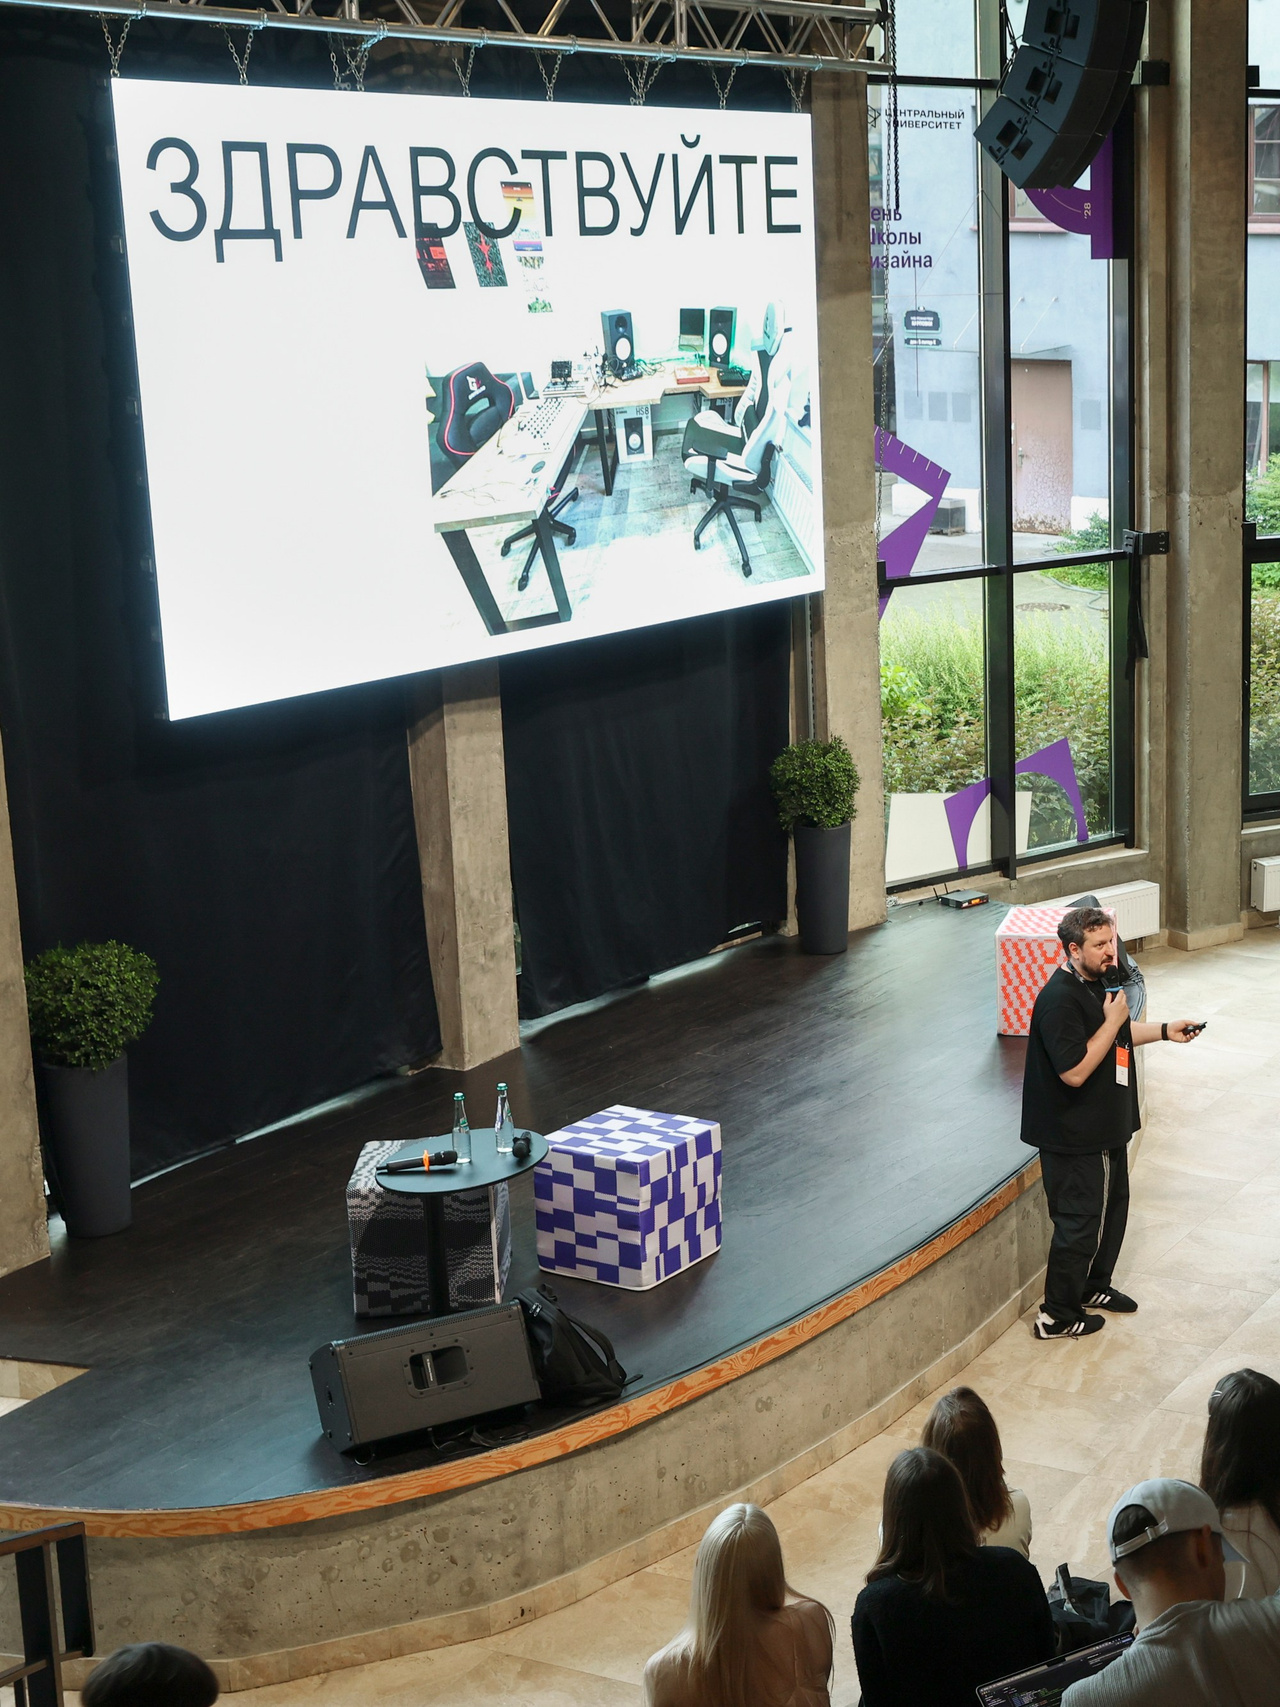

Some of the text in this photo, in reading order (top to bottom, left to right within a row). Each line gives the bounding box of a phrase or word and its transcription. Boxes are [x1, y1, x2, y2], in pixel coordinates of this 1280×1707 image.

[885, 108, 965, 119] ЦНТРАЛЬНЫЙ
[885, 119, 962, 130] УИВЕРСИТЕТ
[146, 133, 802, 264] ЗДРАВСТВУЙТЕ
